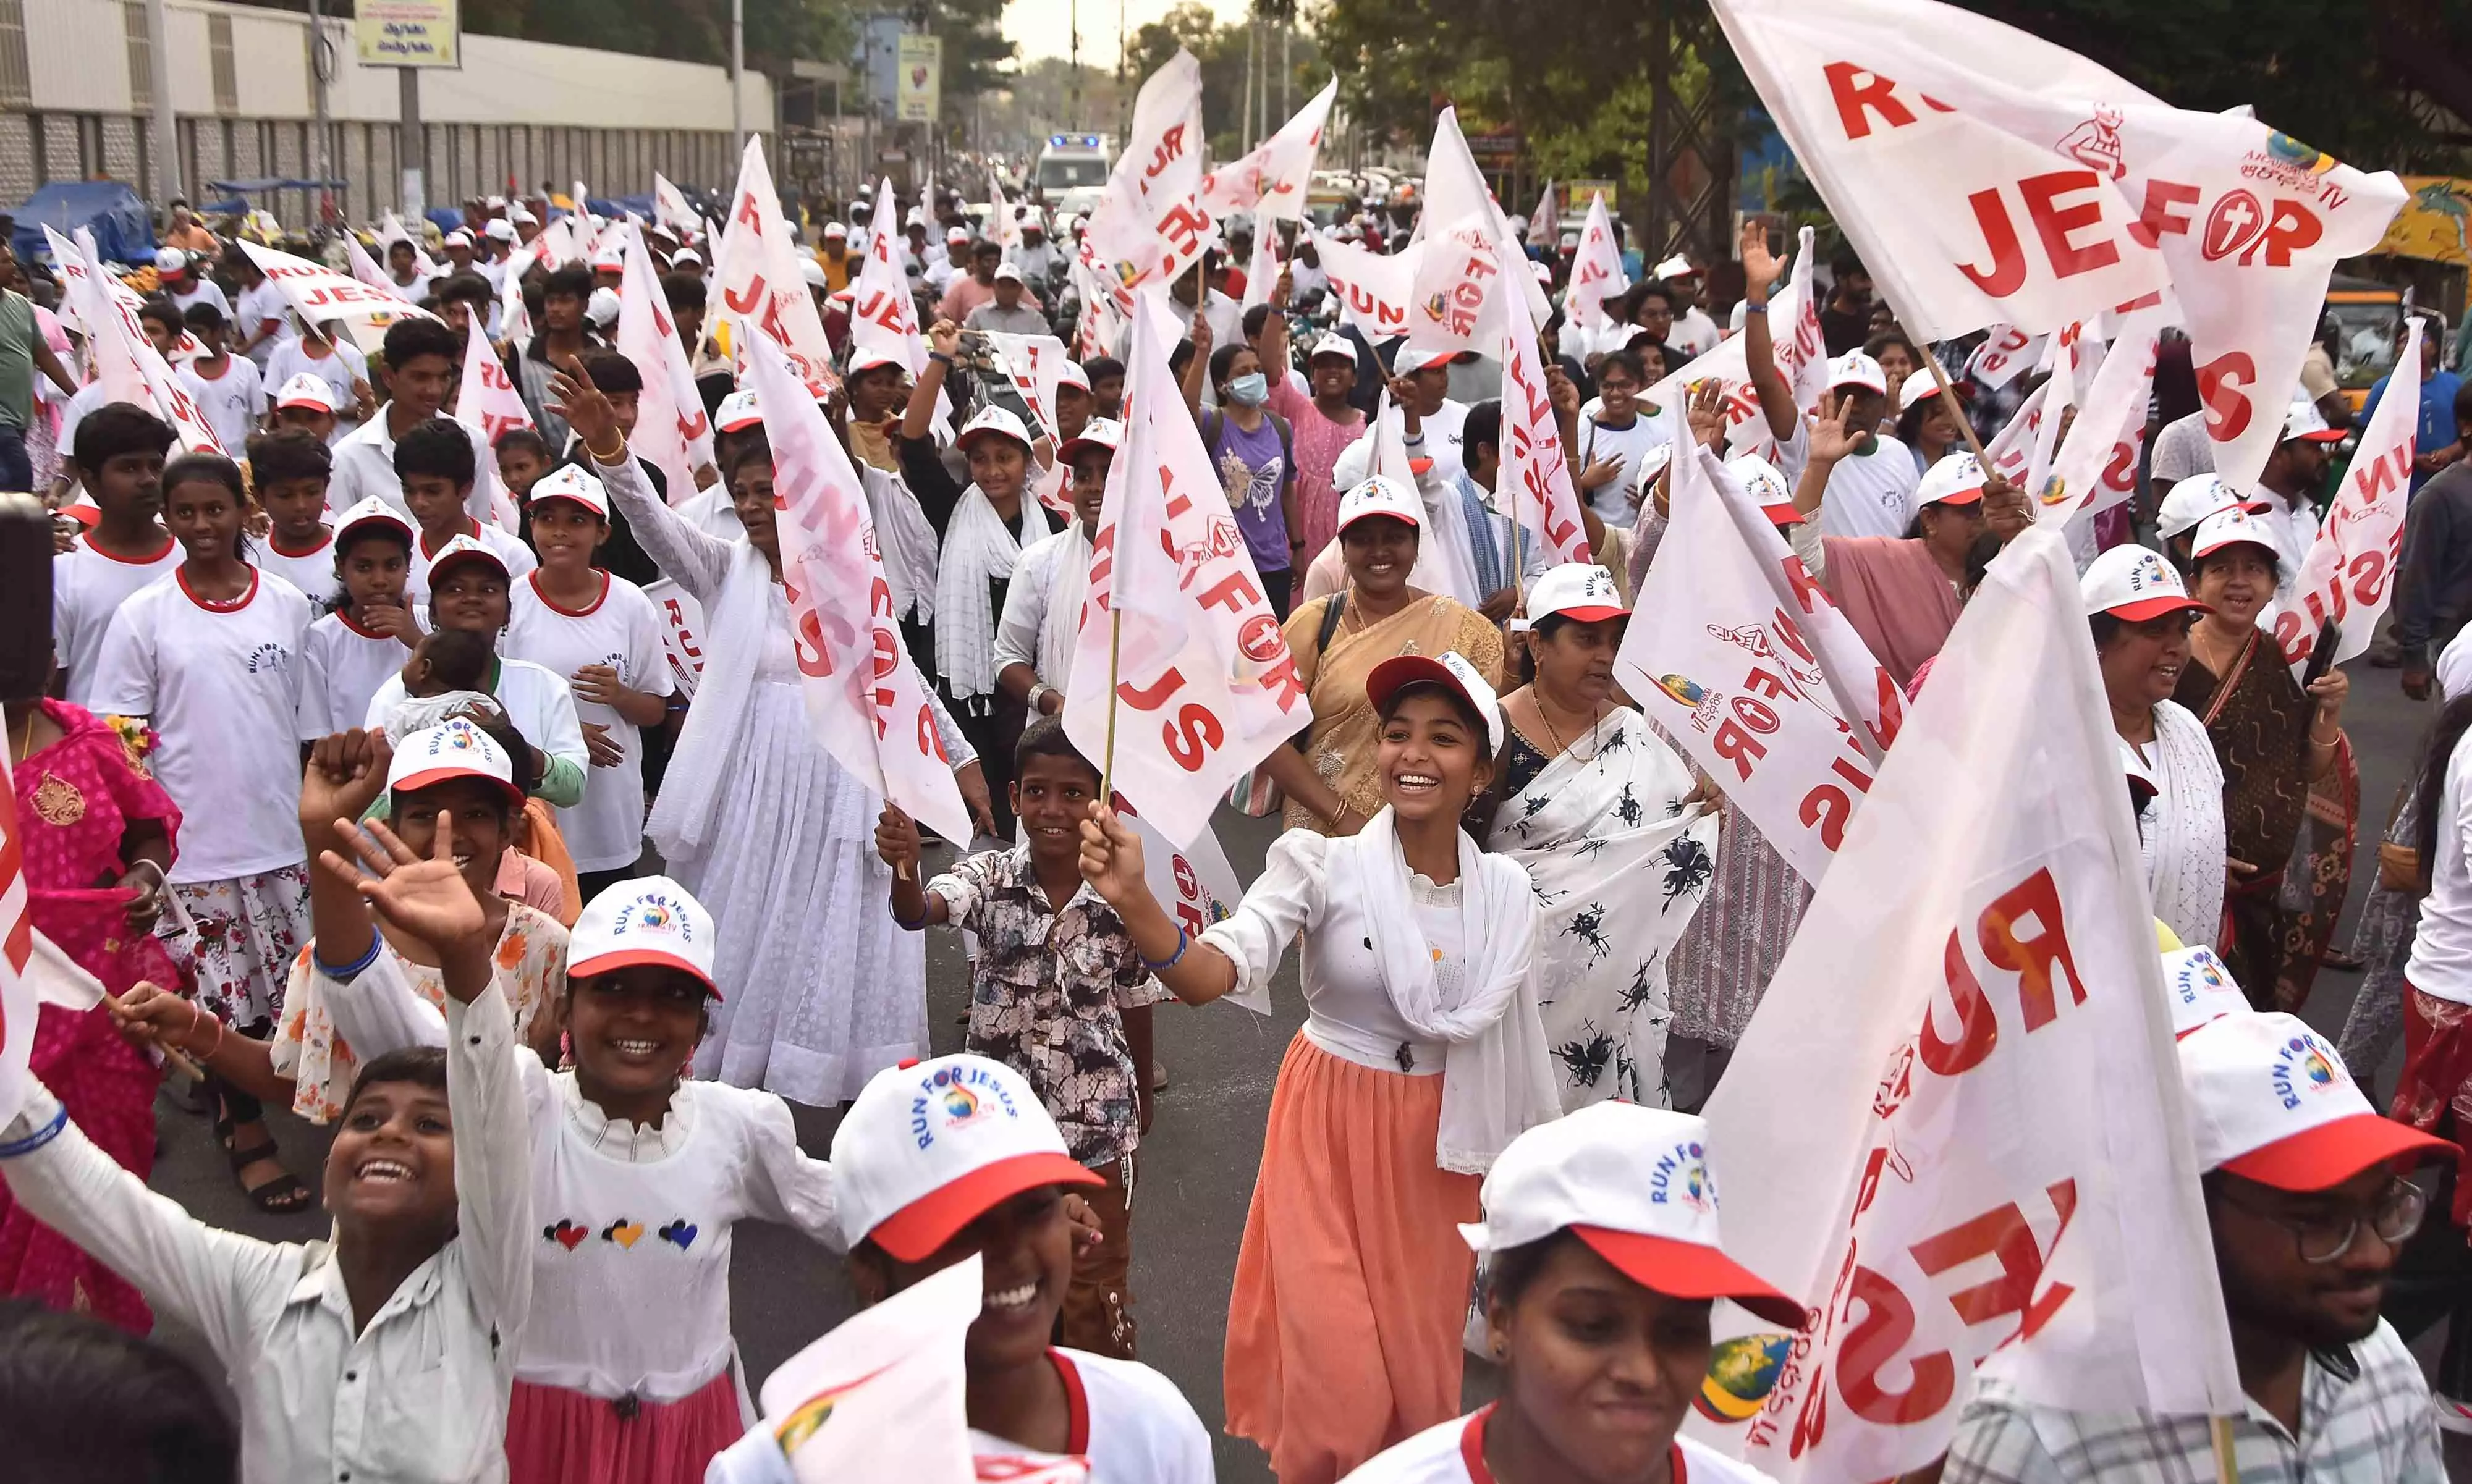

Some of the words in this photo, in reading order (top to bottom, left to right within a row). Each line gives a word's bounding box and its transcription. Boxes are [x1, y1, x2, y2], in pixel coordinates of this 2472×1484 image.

[2318, 181, 2349, 211] TV
[1585, 576, 1596, 597] RUN
[2131, 568, 2143, 592] RUN
[1196, 570, 1308, 715] FOR
[429, 731, 444, 756] RUN
[444, 722, 471, 732] FOR
[473, 731, 493, 763] JESUS
[613, 904, 635, 935] RUN
[637, 894, 666, 907] FOR
[669, 900, 692, 943] JESUS
[2185, 951, 2212, 968] FOR
[2178, 971, 2197, 1004] RUN
[2279, 1033, 2317, 1061] FOR
[920, 1066, 962, 1095] FOR
[968, 1068, 1018, 1120] JESUS
[2272, 1063, 2301, 1110] RUN
[912, 1097, 935, 1150] RUN
[1651, 1154, 1677, 1204] RUN
[1674, 1142, 1704, 1163] FO
